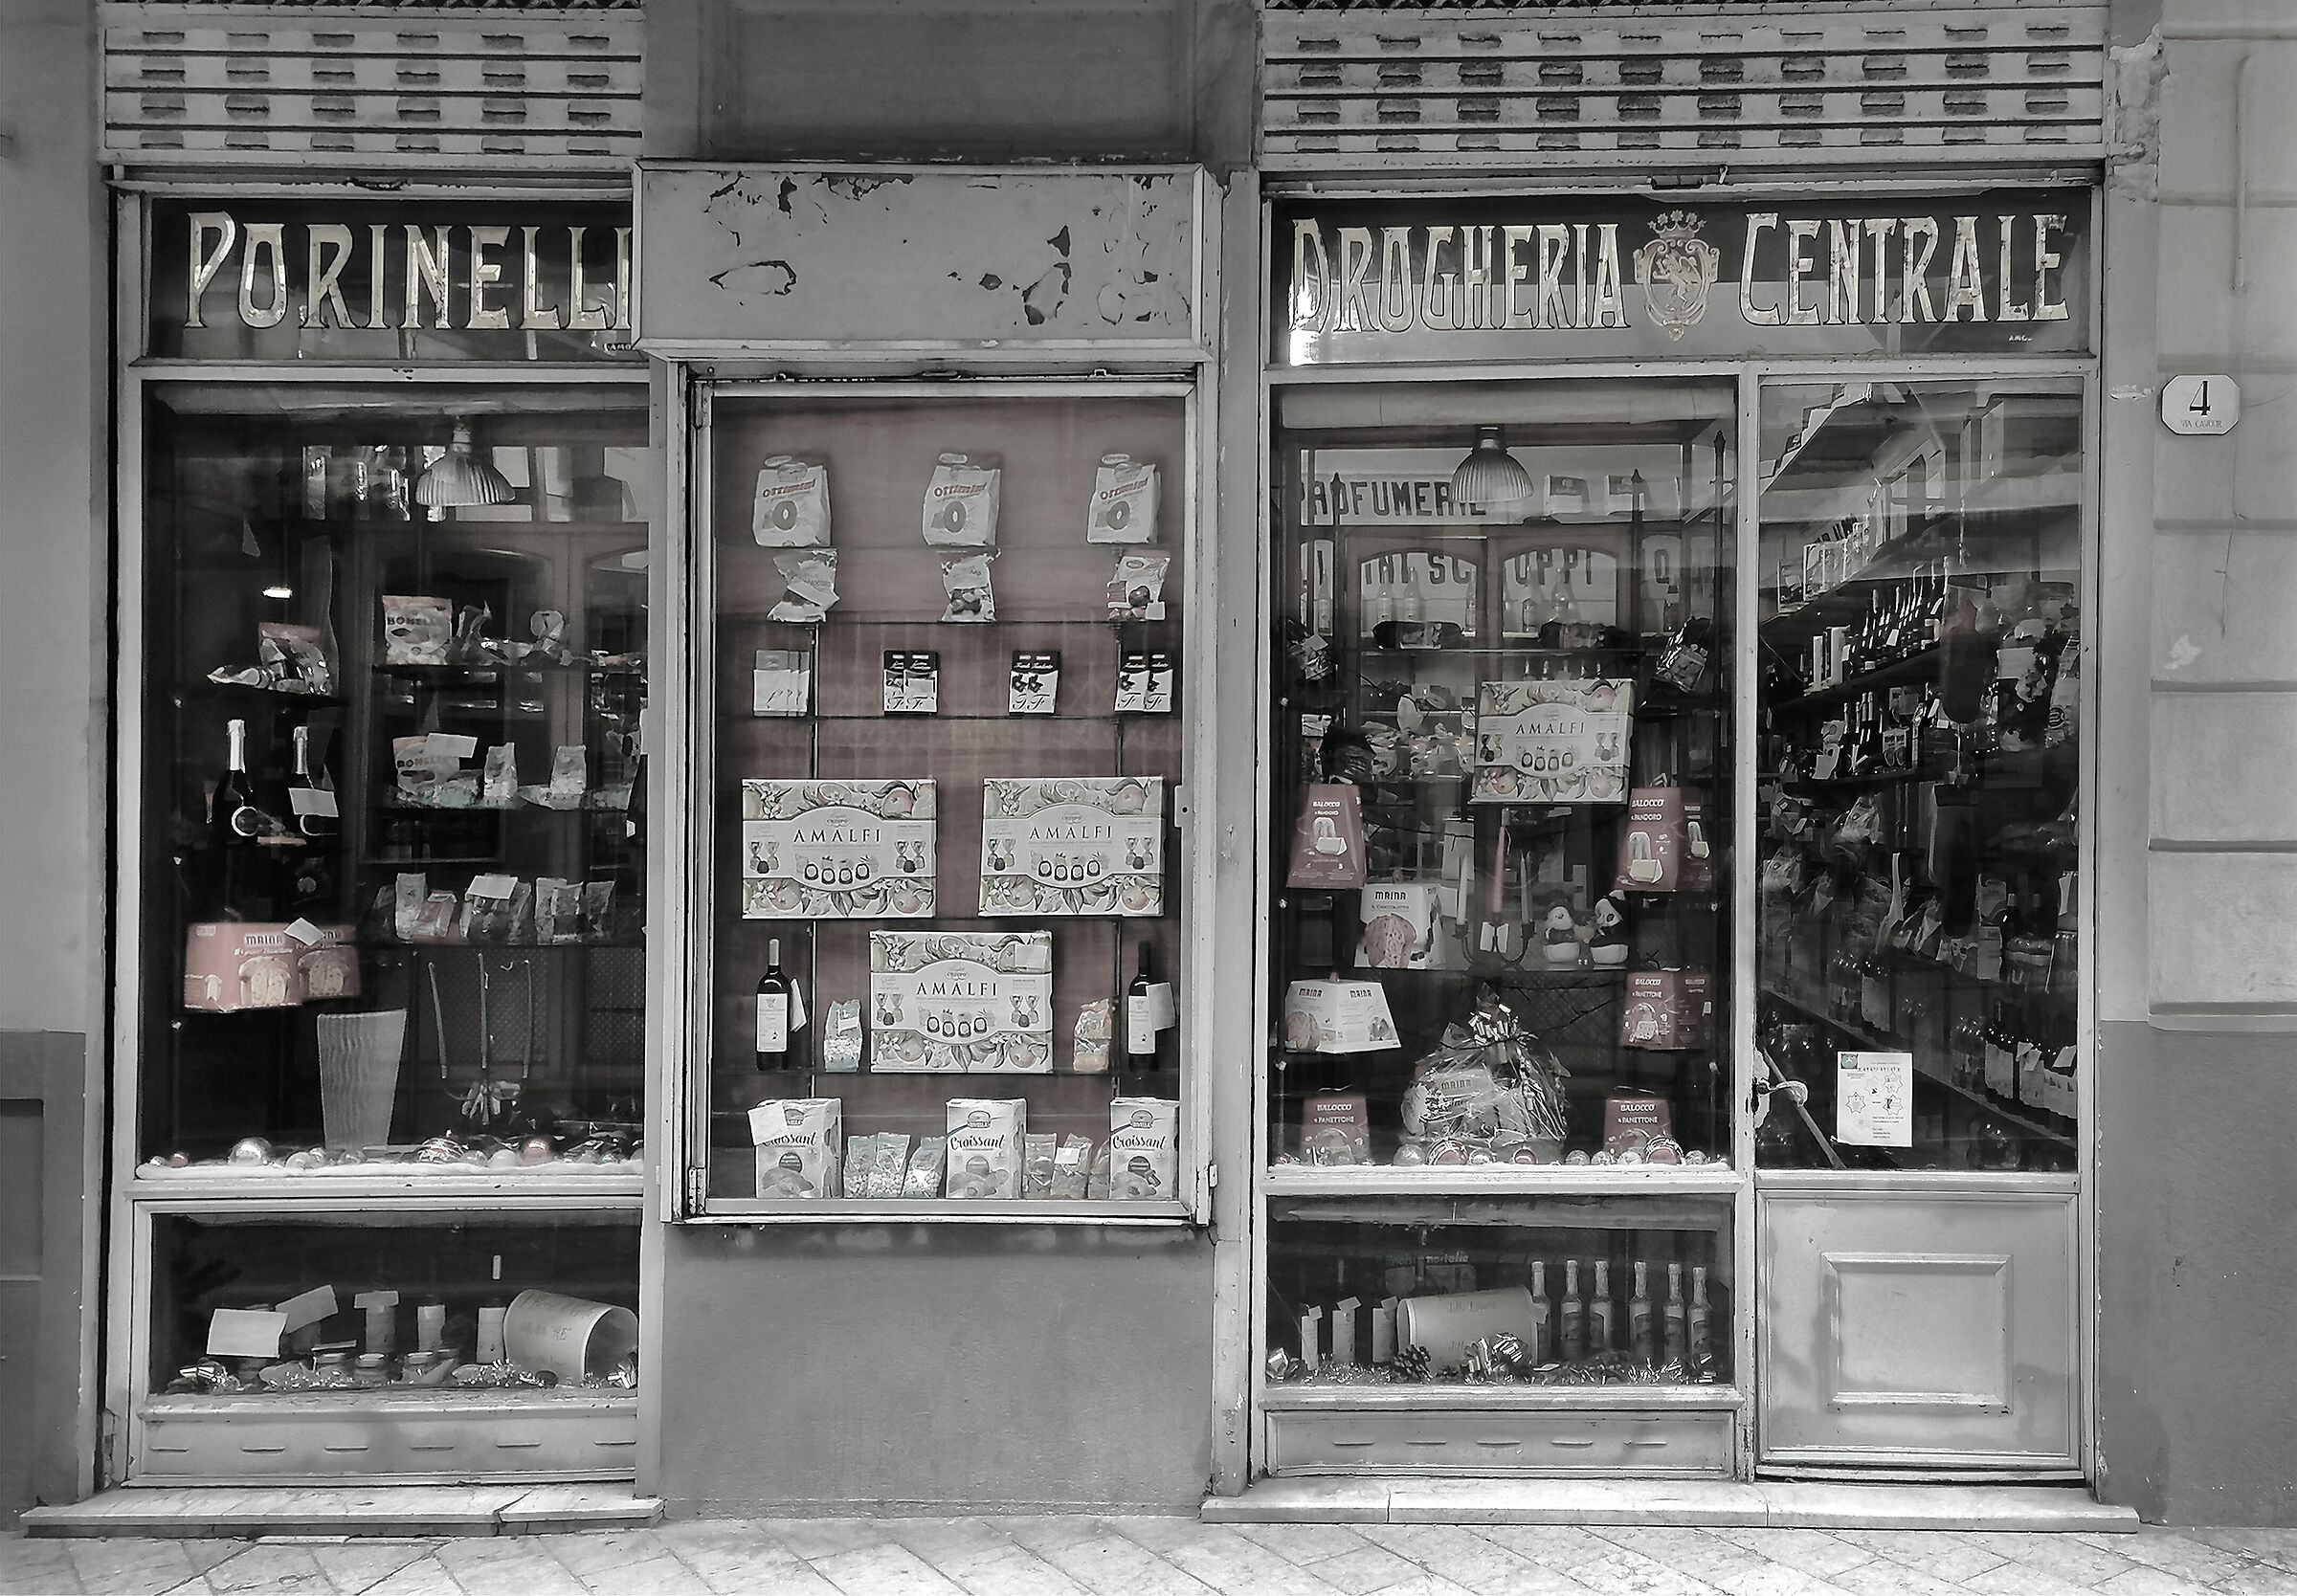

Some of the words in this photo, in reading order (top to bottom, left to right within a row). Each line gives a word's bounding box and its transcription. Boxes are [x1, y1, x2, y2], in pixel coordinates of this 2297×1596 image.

[185, 211, 632, 329] PORINELLI
[1289, 217, 1631, 333] DROGHERIA
[1738, 212, 2070, 325] CENTRALE
[2189, 381, 2211, 415] 4
[1300, 480, 1486, 517] ROFUMER
[1516, 721, 1585, 735] AMALFI
[793, 829, 881, 843] AMALFI
[1030, 825, 1112, 840] AMALFI
[1375, 891, 1406, 900] MAINA
[916, 982, 998, 996] AMALFI
[762, 1131, 816, 1147] roissant
[950, 1134, 1005, 1150] Croissant
[1112, 1135, 1166, 1150] Croissant
